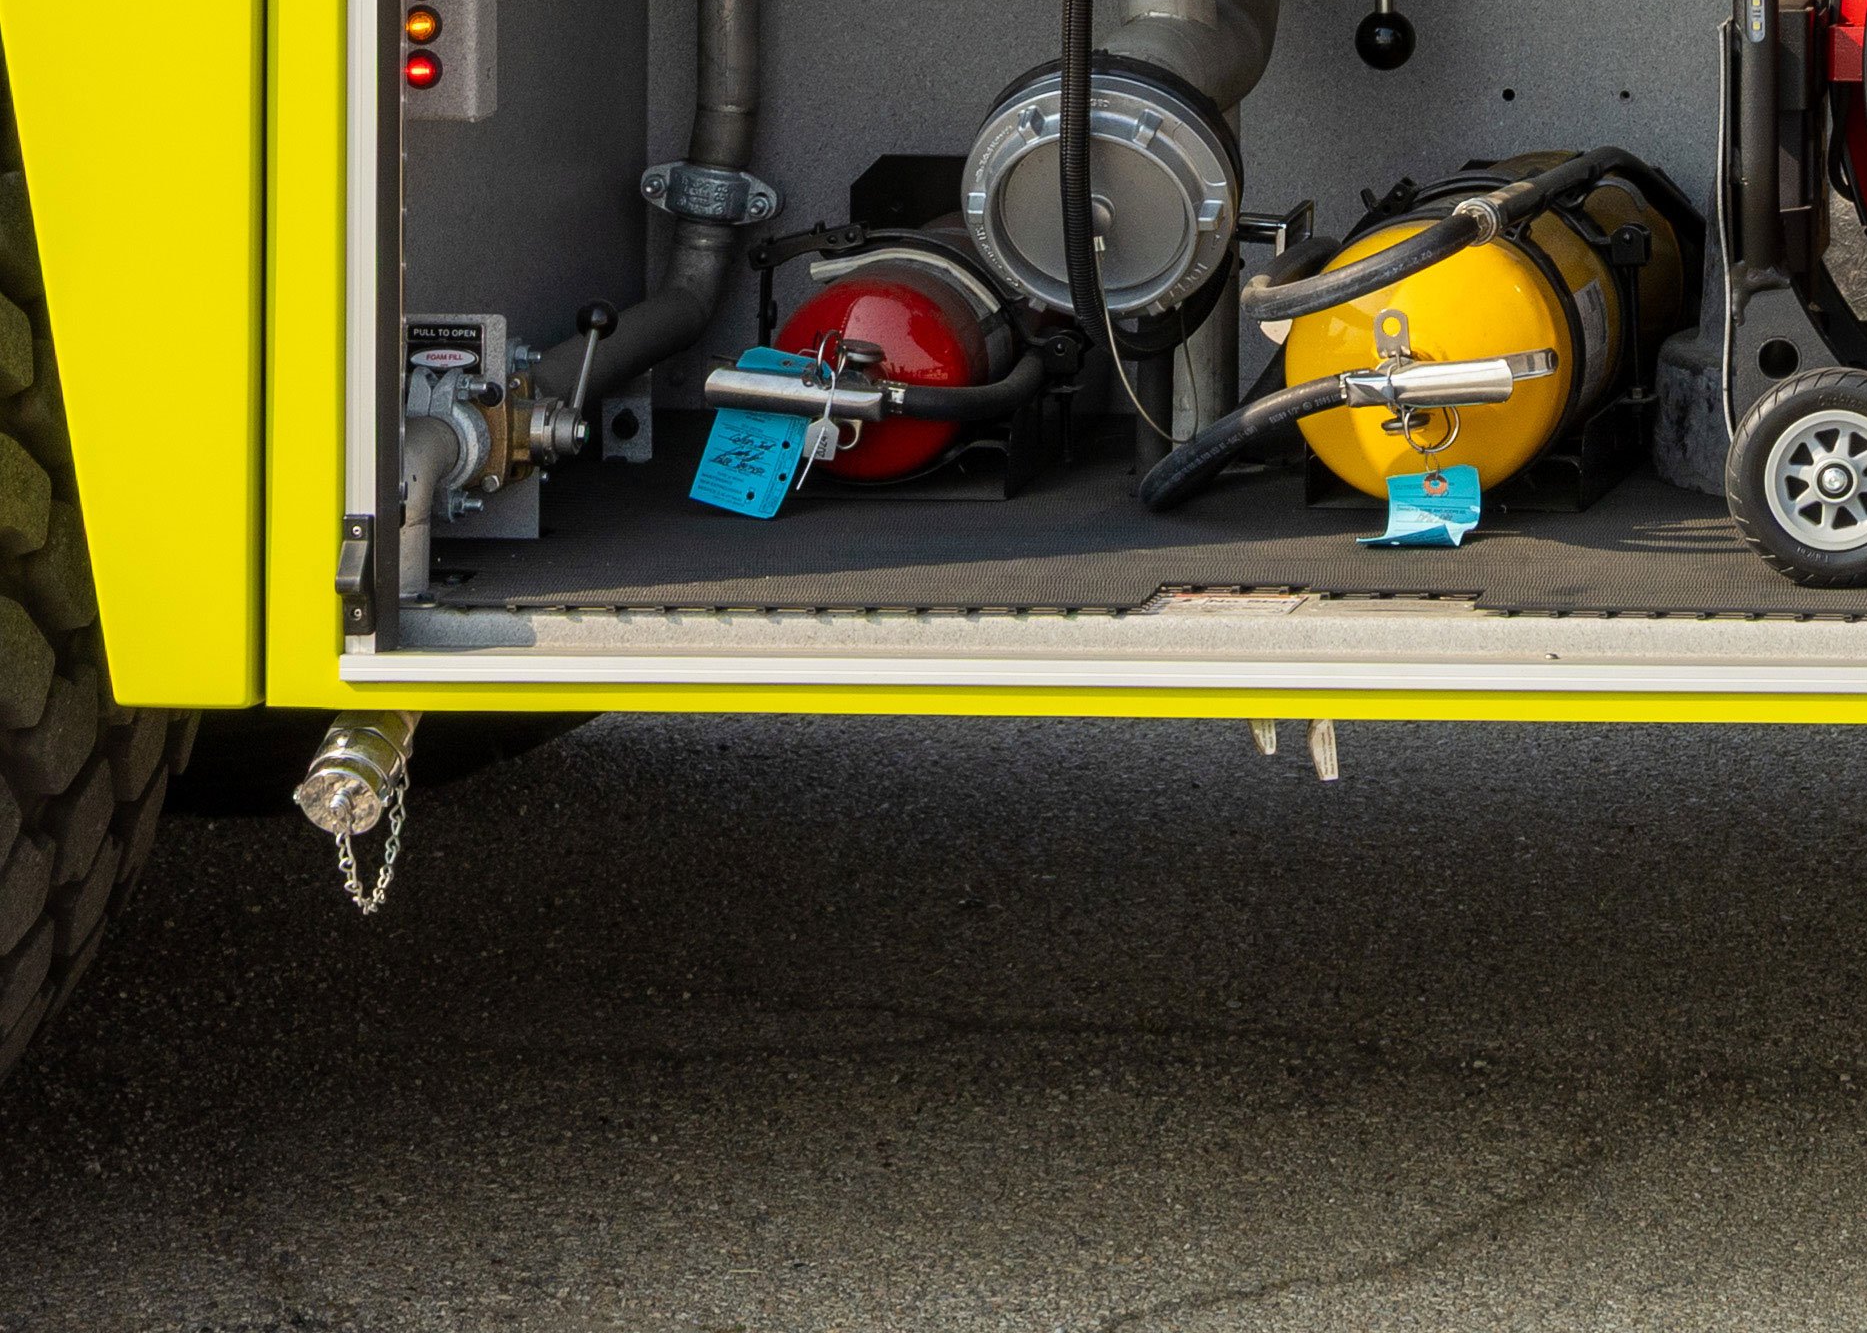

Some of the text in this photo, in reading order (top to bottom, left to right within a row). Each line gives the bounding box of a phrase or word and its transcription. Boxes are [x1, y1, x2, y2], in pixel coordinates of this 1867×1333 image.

[413, 328, 476, 338] PULL TO OPEN
[426, 353, 447, 361] FOAM
